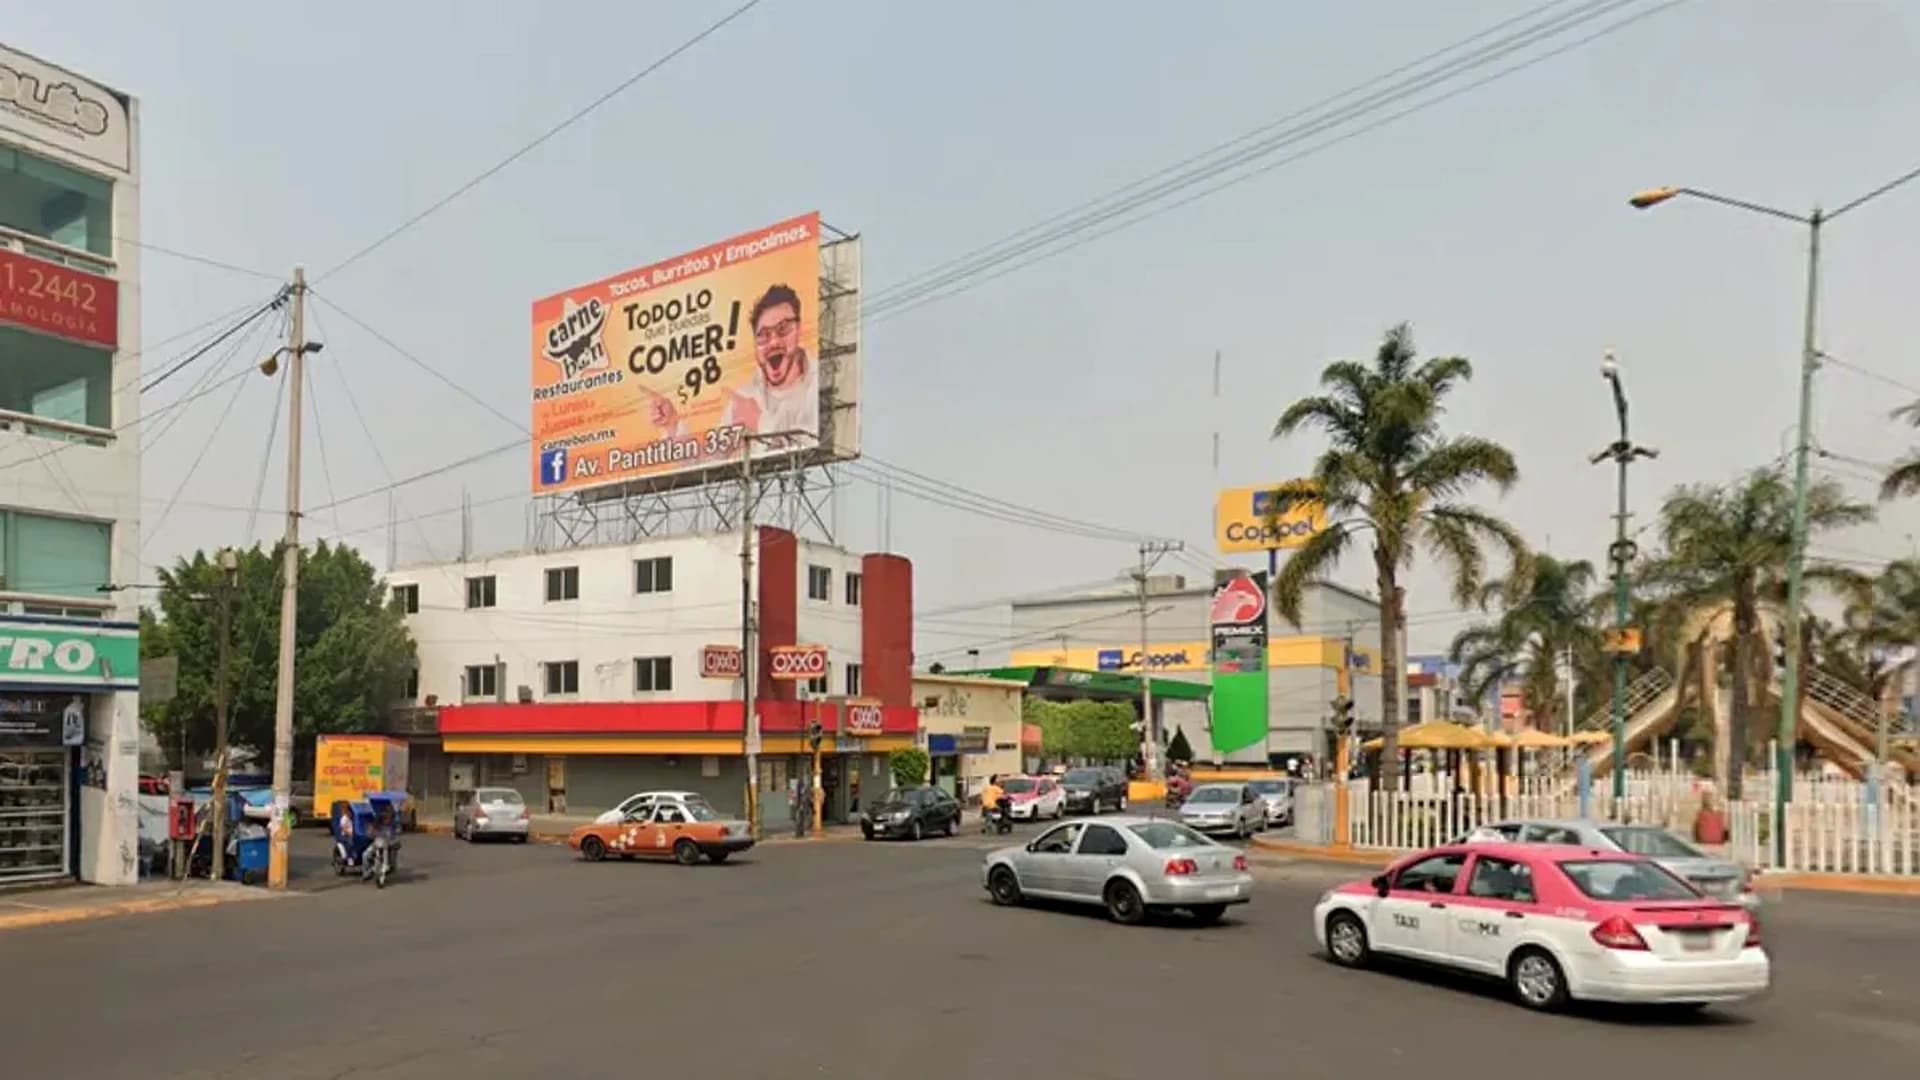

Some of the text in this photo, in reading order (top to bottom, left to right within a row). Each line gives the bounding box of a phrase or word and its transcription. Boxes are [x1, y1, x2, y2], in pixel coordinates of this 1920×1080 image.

[608, 276, 650, 297] Tacos,
[652, 255, 710, 285] Burritos
[712, 252, 724, 271] y
[549, 299, 600, 348] carne
[623, 289, 712, 331] TODO LO
[645, 312, 711, 340] que puedas
[534, 370, 624, 399] Restaurantes
[541, 429, 616, 450] carnebon.mx
[608, 439, 698, 472] Pantitlan
[706, 425, 745, 454] 357
[1227, 516, 1314, 544] Coppel
[706, 653, 740, 670] OXXO
[773, 652, 823, 671] OXXO
[1131, 650, 1190, 672] Coppel
[851, 706, 882, 728] OXXO
[1393, 913, 1419, 929] TAXI
